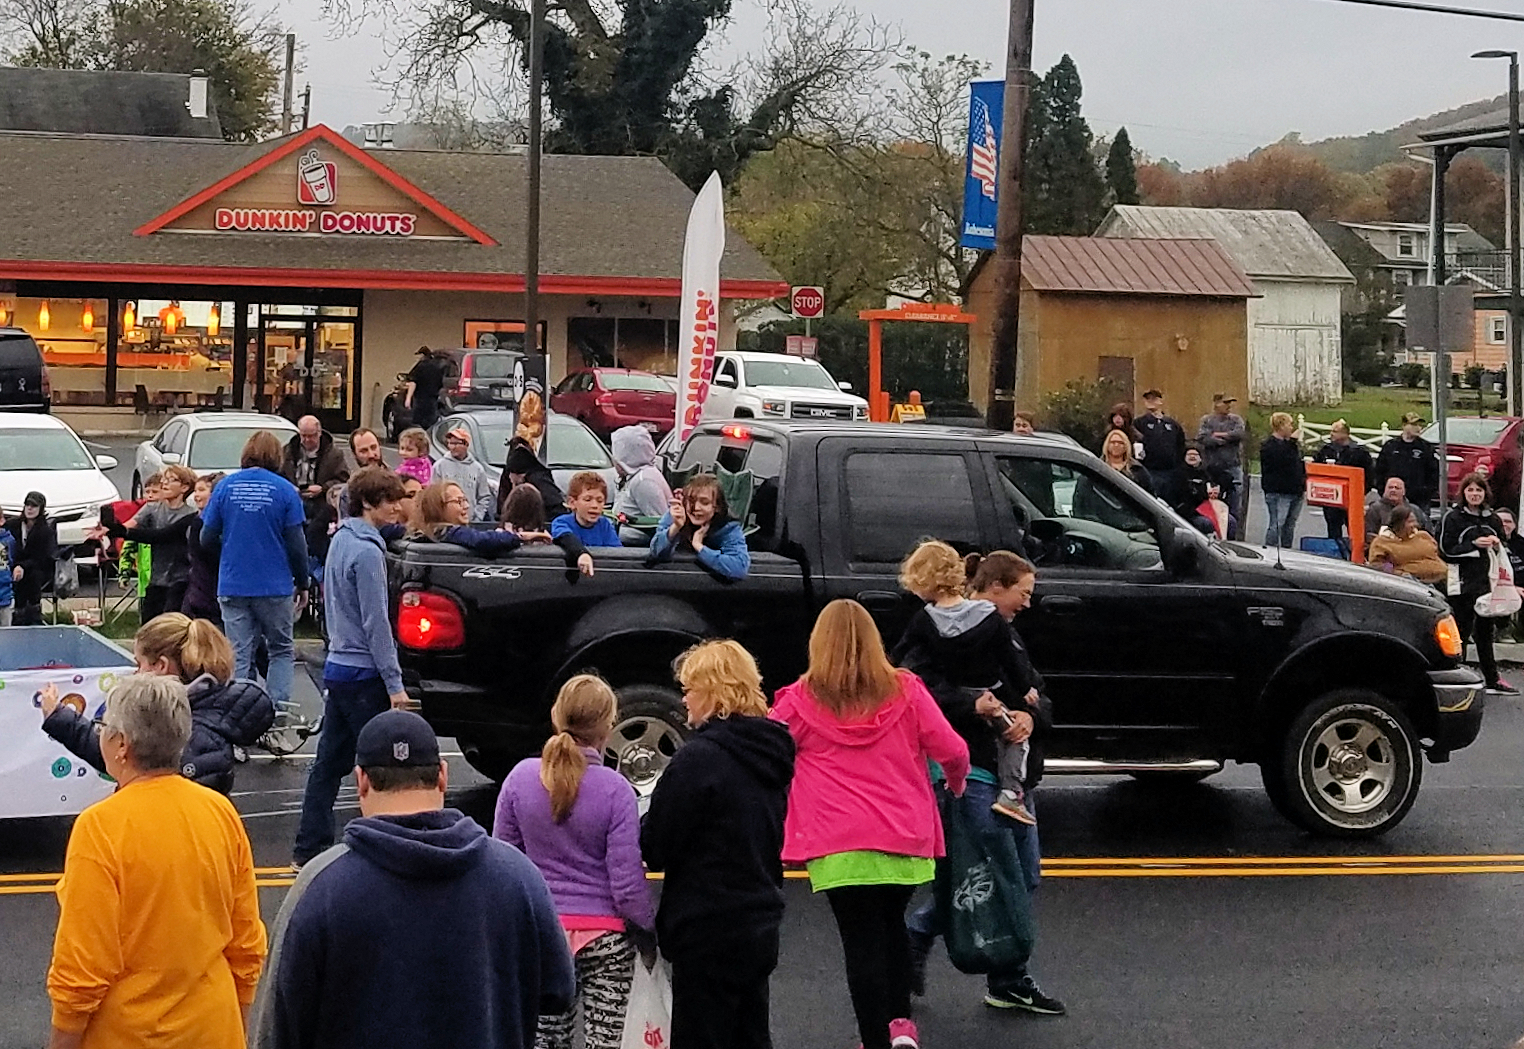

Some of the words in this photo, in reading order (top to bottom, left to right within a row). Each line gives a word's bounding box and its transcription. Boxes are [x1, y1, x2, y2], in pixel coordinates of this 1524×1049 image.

[216, 210, 315, 230] DUNKIN'
[321, 212, 414, 234] DONUTS
[794, 296, 821, 308] STOP
[810, 408, 837, 417] GMC
